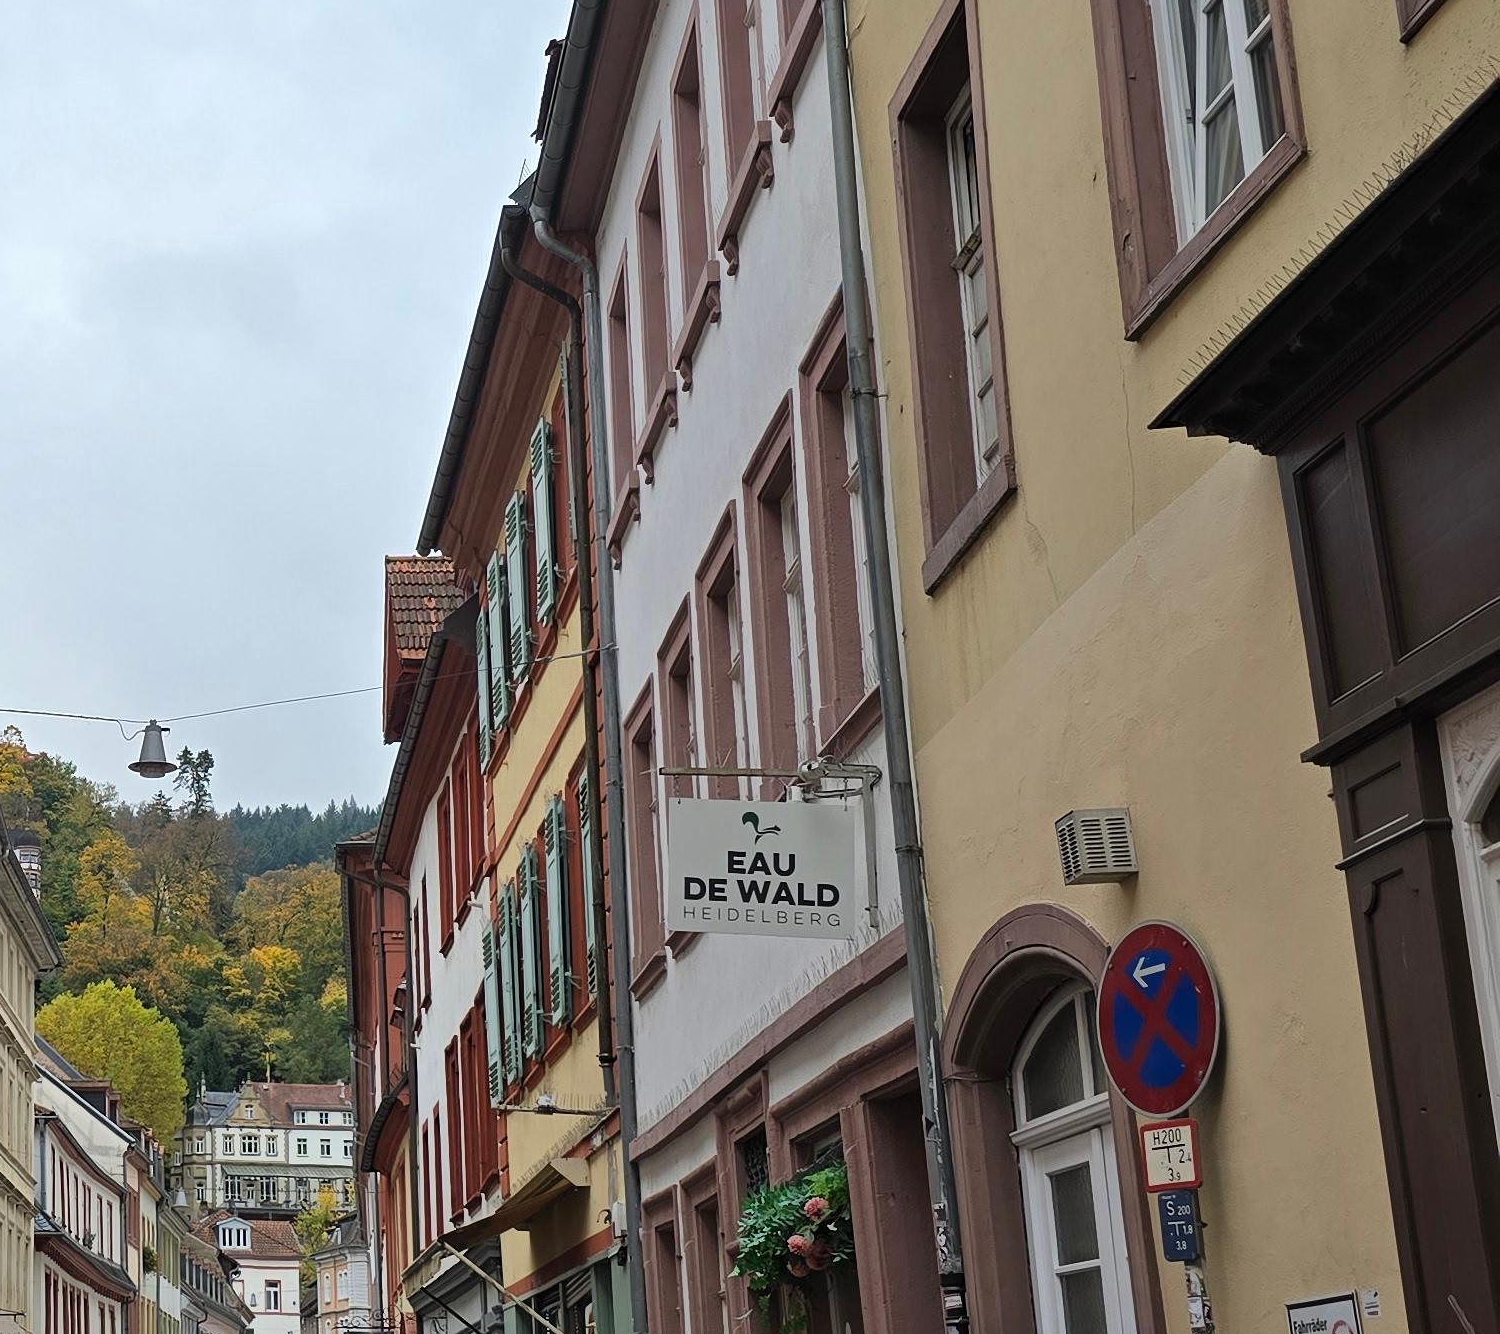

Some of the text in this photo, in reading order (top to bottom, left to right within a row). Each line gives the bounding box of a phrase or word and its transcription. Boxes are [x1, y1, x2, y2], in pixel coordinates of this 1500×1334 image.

[727, 850, 796, 877] EAU
[683, 876, 840, 908] DE WALD
[683, 905, 841, 927] HEIDELBERG
[1153, 1127, 1182, 1146] H200
[1293, 1318, 1328, 1334] Fahrräder
